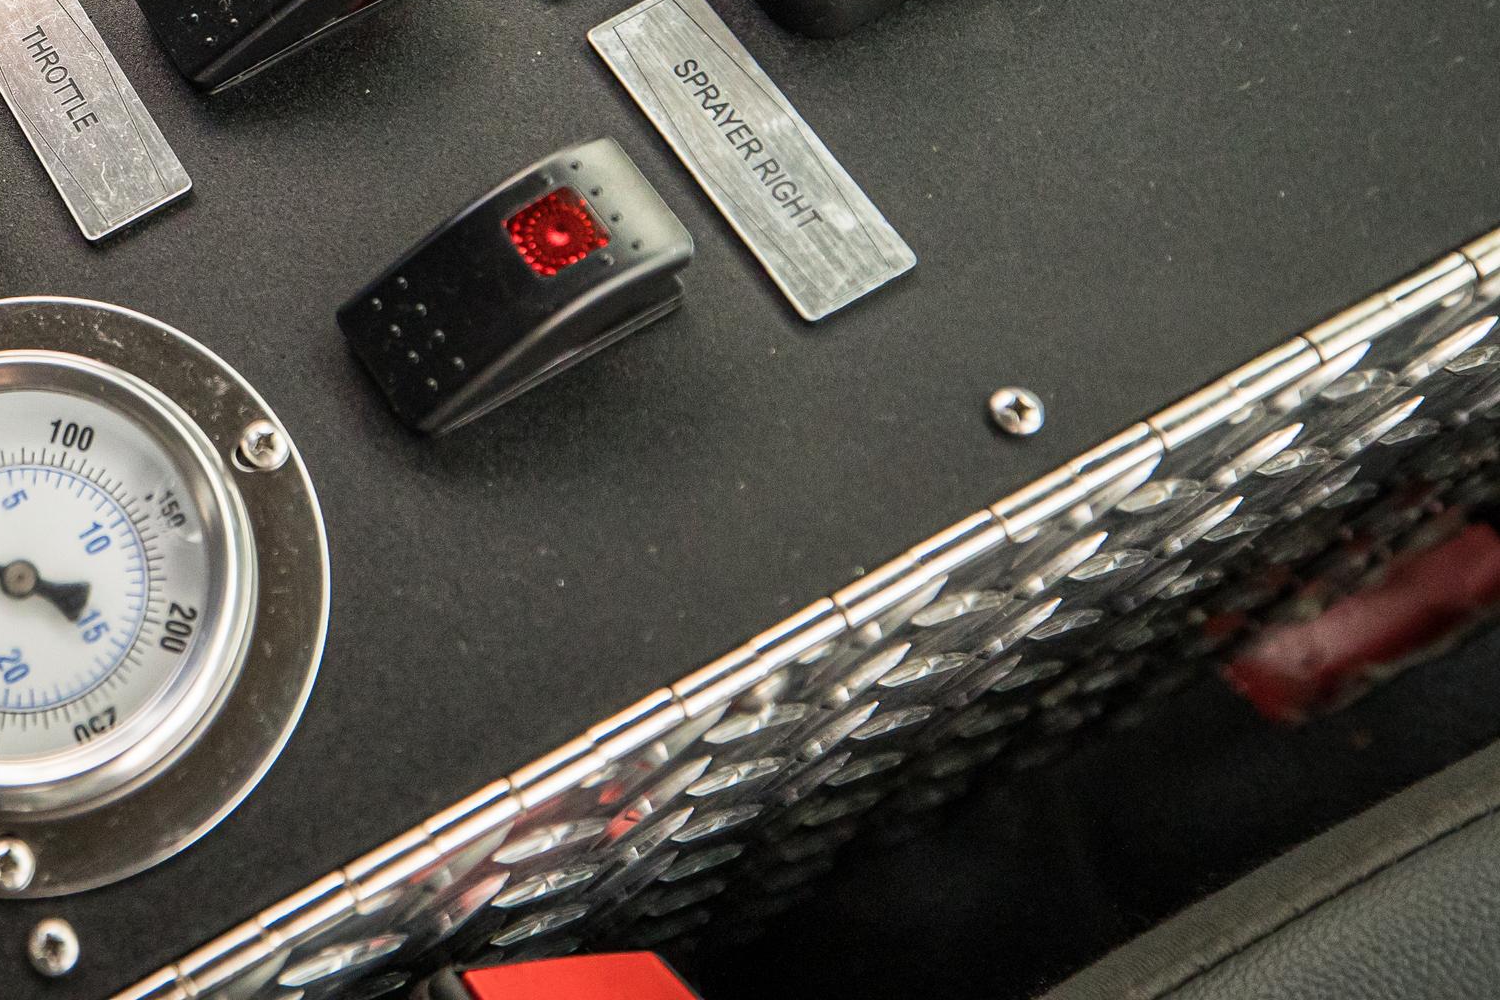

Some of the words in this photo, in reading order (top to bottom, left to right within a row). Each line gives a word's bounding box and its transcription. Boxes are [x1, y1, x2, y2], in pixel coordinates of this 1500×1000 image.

[21, 24, 99, 133] THROTTLE
[673, 59, 763, 161] SPRAYER
[753, 158, 823, 228] RIGHT
[49, 418, 95, 452] 100
[1, 489, 29, 512] 5
[159, 490, 187, 528] 150
[78, 521, 112, 556] 10
[76, 608, 110, 644] 15
[159, 601, 198, 655] 200
